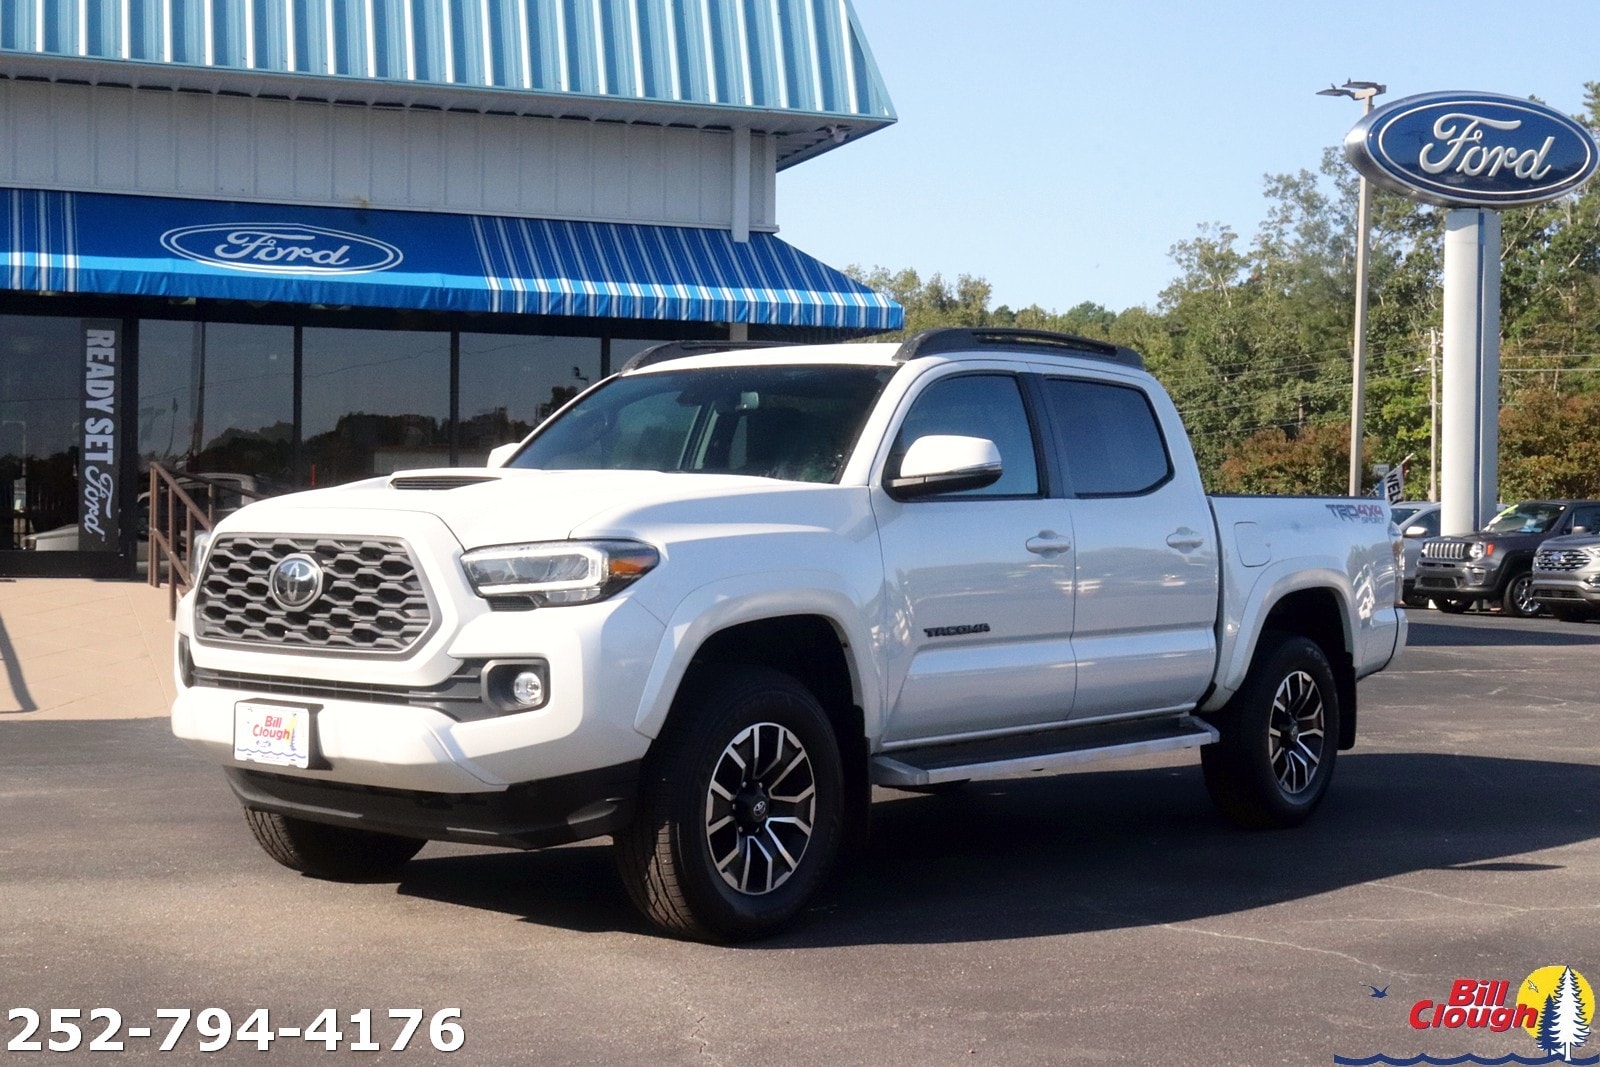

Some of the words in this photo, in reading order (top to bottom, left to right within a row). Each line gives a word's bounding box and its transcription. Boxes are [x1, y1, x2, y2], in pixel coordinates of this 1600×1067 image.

[1419, 113, 1555, 180] Ford
[214, 231, 350, 265] Ford
[86, 329, 115, 414] READY
[85, 417, 114, 465] SET
[84, 466, 113, 536] Ford
[923, 622, 990, 638] TACOMA
[252, 724, 290, 741] Clough
[265, 715, 283, 728] Bill
